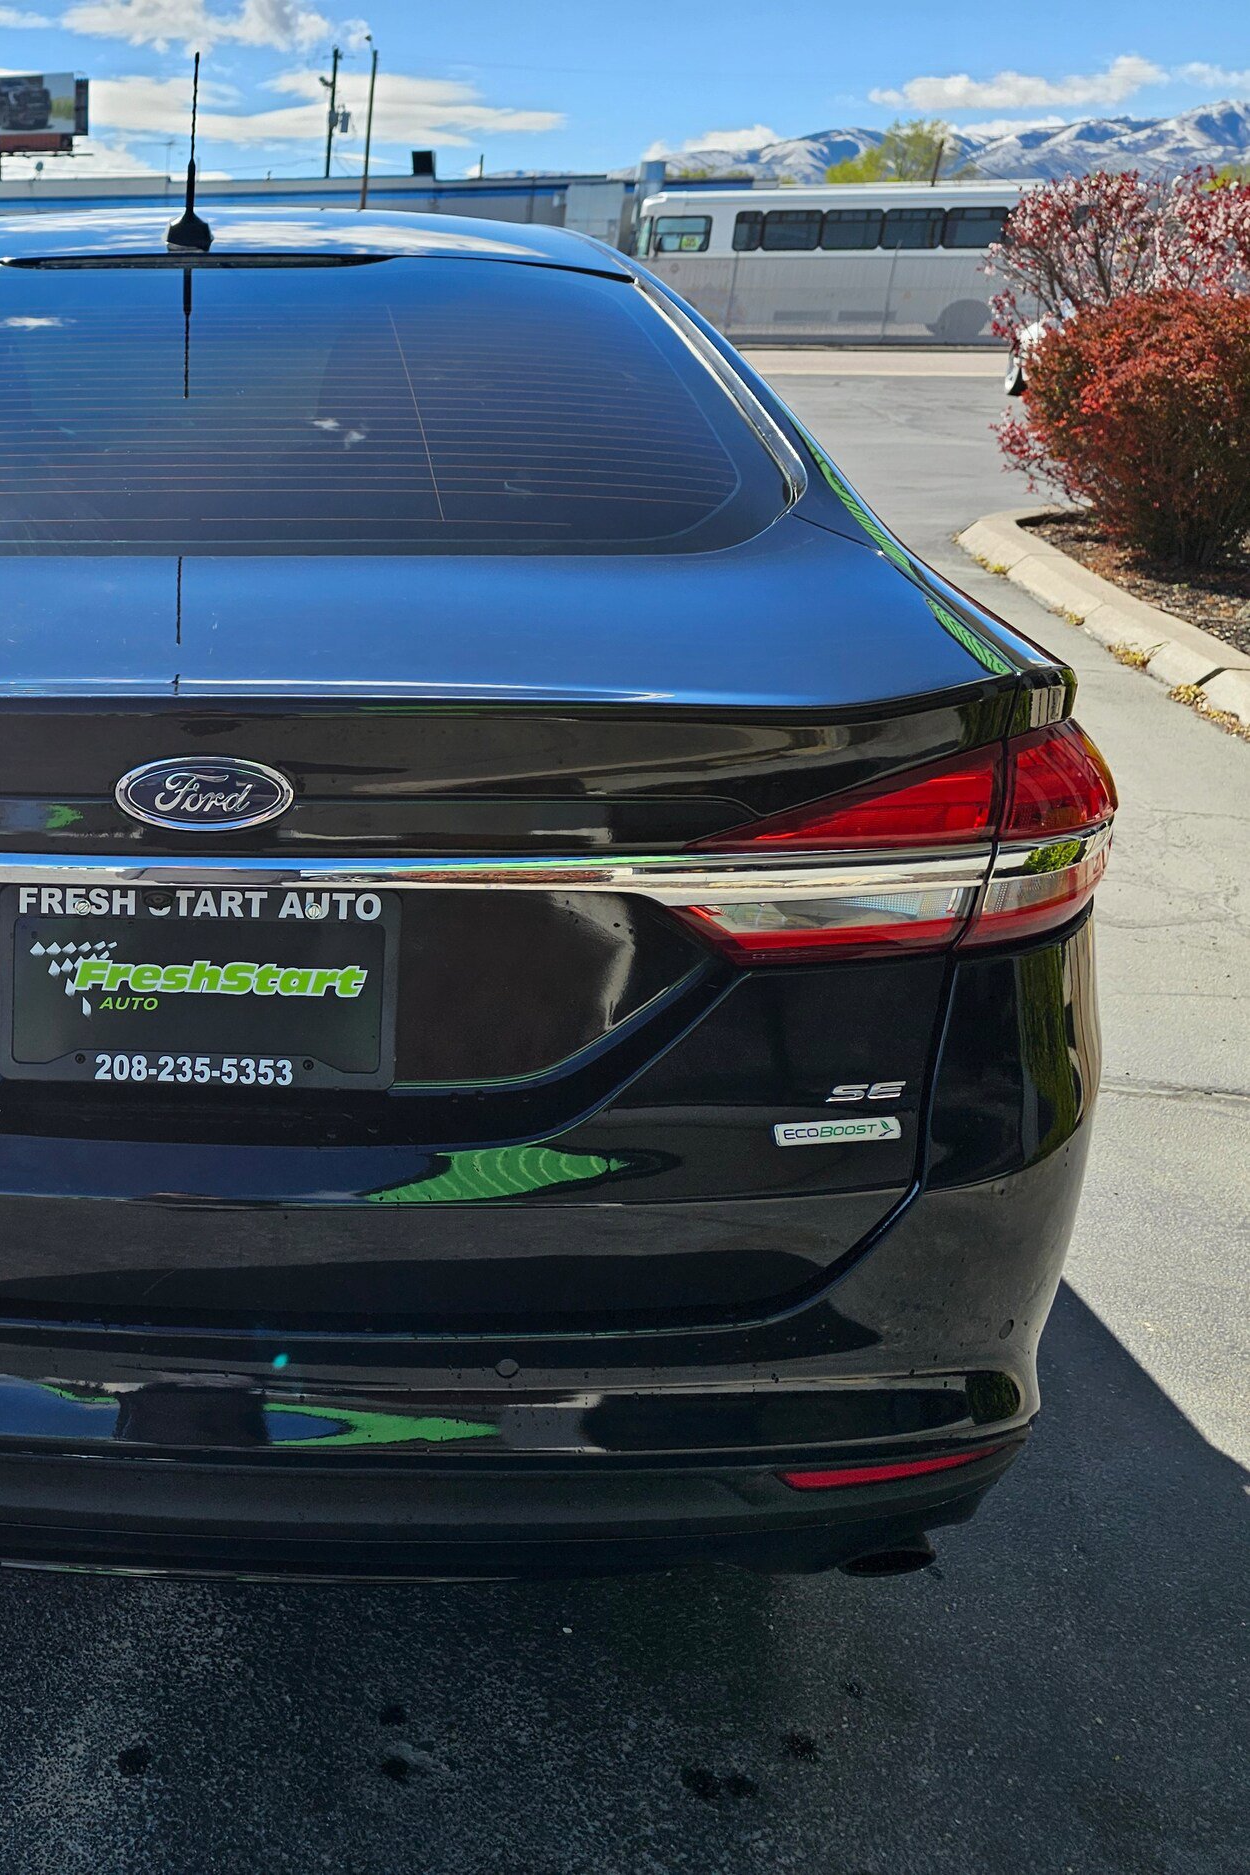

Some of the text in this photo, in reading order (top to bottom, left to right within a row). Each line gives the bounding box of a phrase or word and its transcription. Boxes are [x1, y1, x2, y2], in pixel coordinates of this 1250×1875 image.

[154, 772, 253, 812] Ford
[18, 886, 137, 917] FRESH
[278, 891, 383, 922] AUTO
[73, 958, 369, 999] FreshStart
[99, 996, 160, 1012] AUTO
[93, 1053, 295, 1087] 208-235-5353
[825, 1080, 907, 1103] SE
[782, 1123, 878, 1141] ECOBOOST
